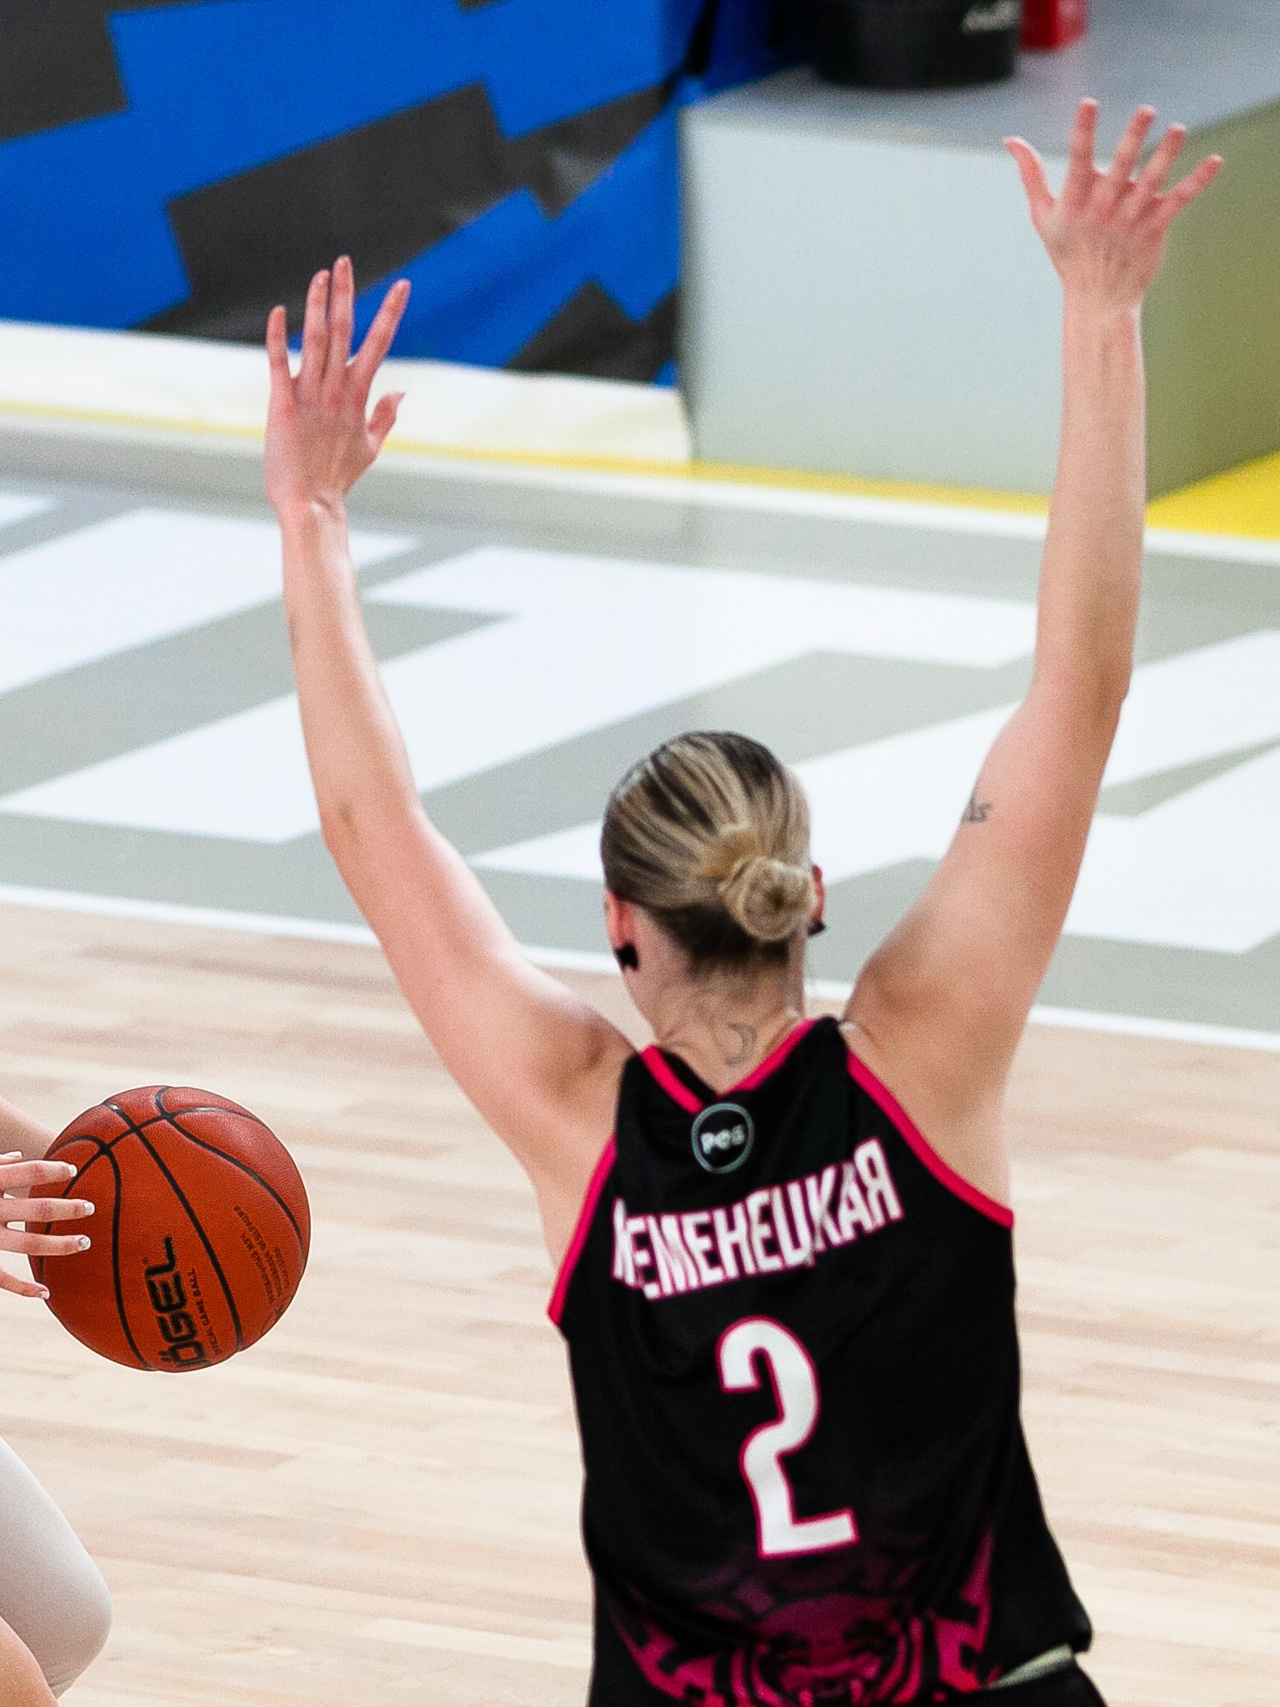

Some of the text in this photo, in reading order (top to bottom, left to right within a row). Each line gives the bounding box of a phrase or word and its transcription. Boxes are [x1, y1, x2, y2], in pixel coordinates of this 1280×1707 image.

[144, 1233, 212, 1367] ÖGEL
[187, 1267, 201, 1297] BALL
[195, 1298, 211, 1326] GAME
[716, 1316, 858, 1559] 2
